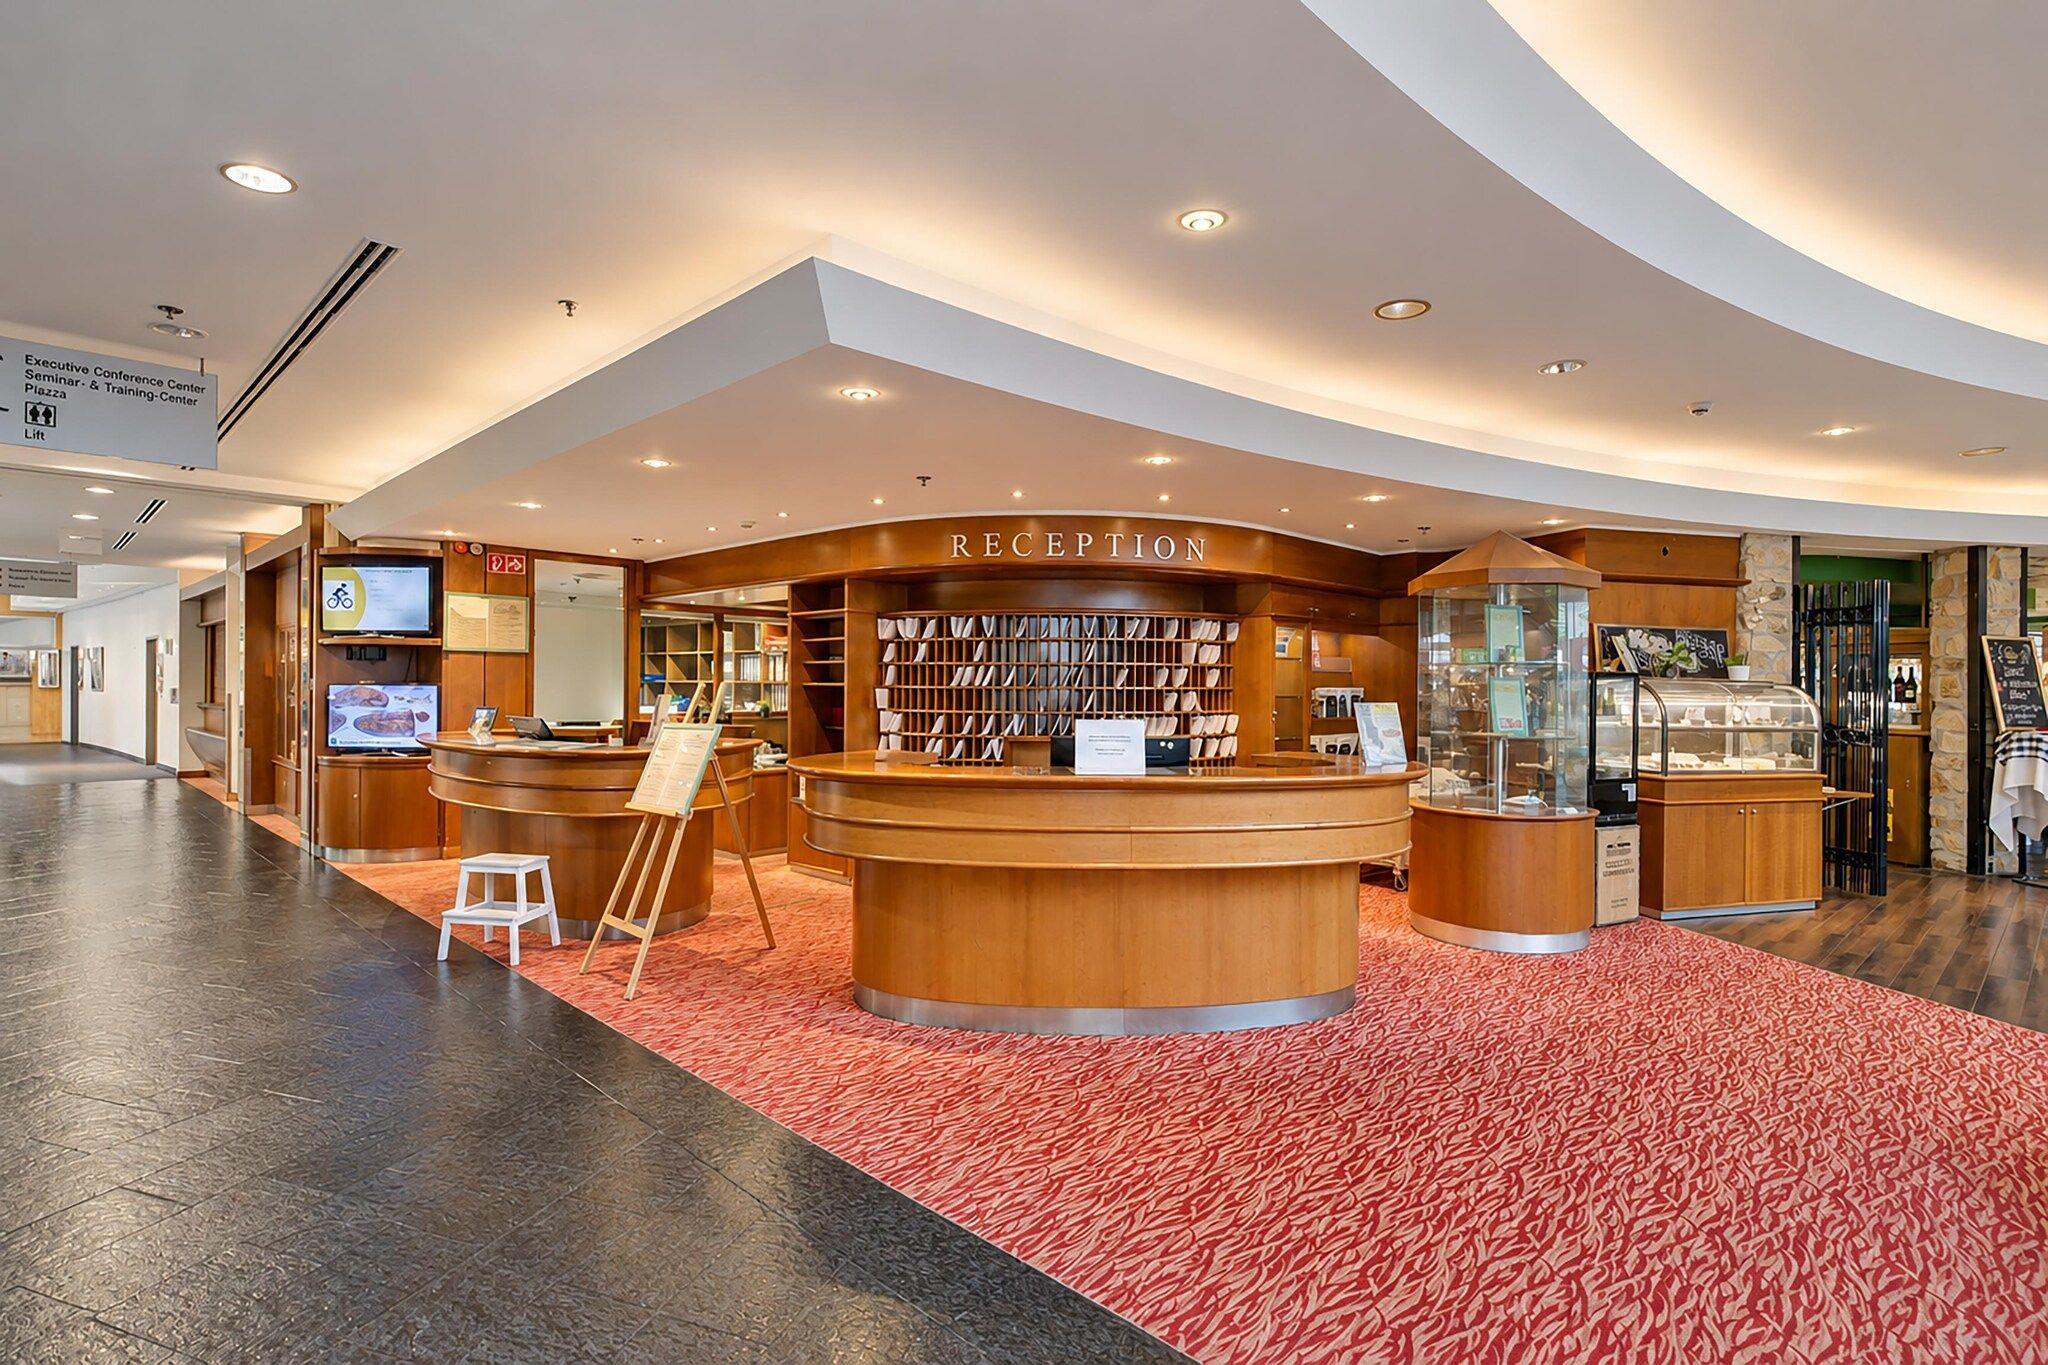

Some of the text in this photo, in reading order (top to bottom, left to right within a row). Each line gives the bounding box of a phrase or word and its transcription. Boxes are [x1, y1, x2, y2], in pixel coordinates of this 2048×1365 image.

[25, 354, 206, 394] Executive Conference Center
[25, 368, 198, 406] Seminar- & Training-Center
[25, 383, 67, 399] Piazza
[25, 428, 46, 441] Lift
[950, 532, 1206, 562] RECEPTION
